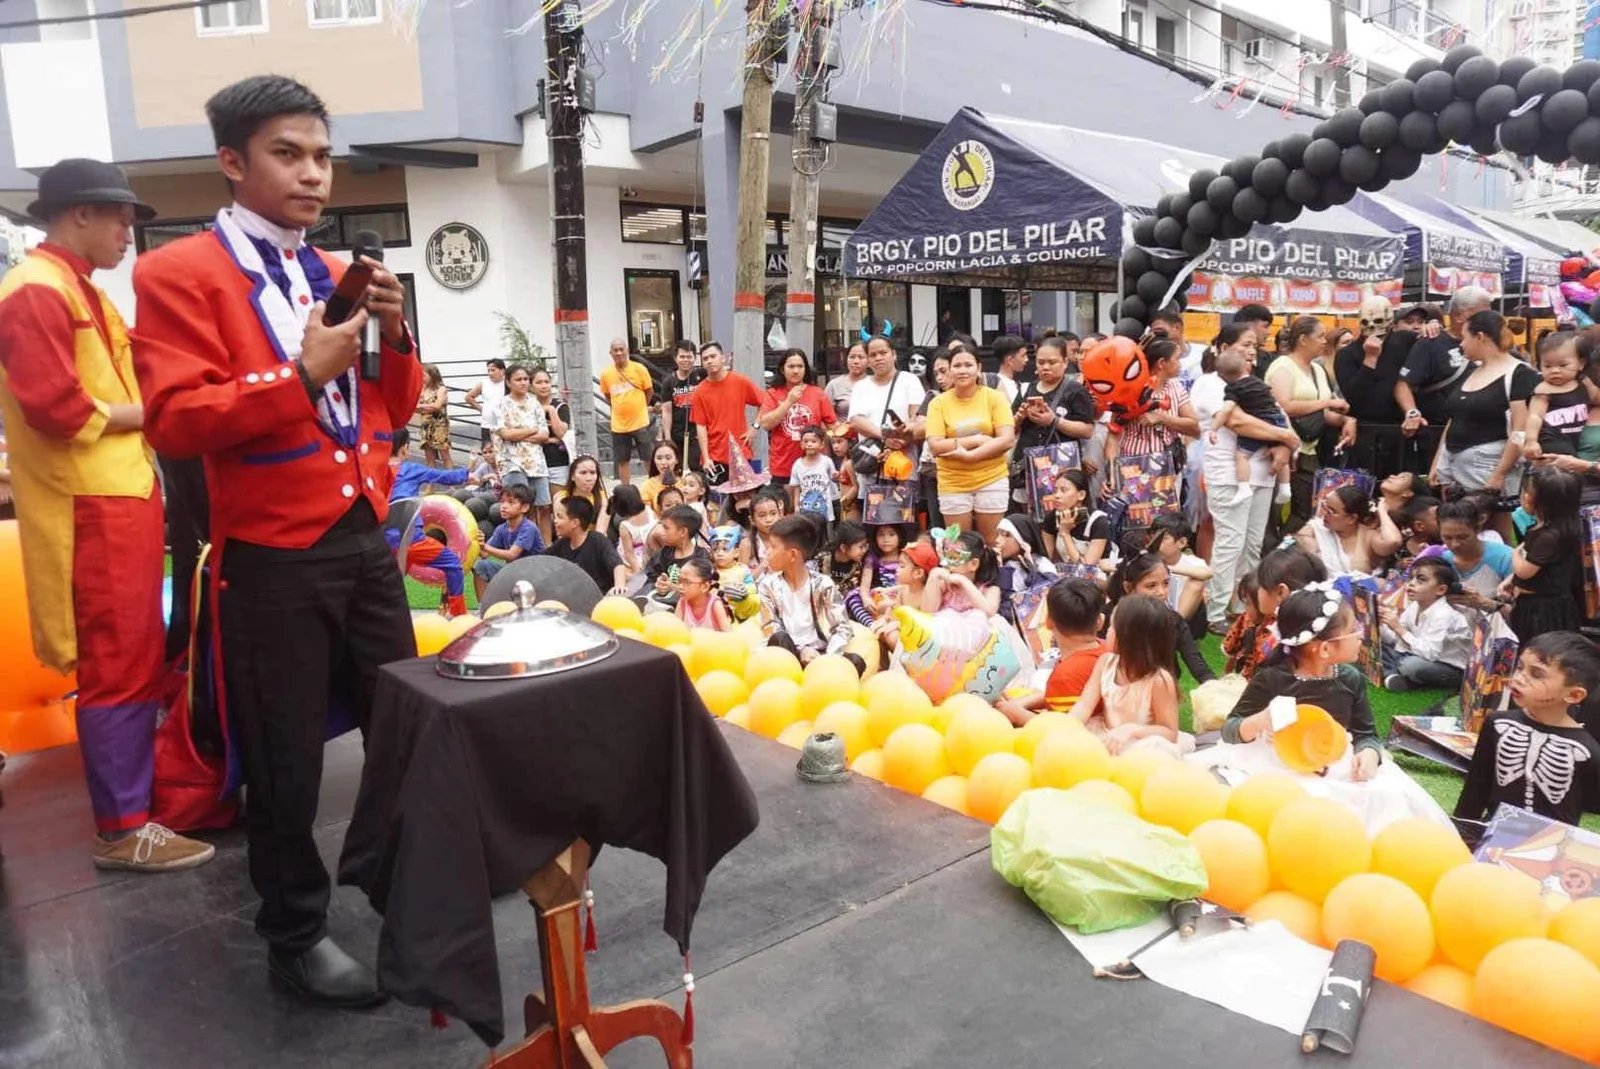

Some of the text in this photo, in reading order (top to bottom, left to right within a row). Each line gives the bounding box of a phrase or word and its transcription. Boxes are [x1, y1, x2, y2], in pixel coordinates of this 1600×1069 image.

[857, 216, 1107, 264] BRGY. PIO DEL PILAR
[856, 246, 1106, 276] KAP. POPCORN LACIA & COUNCIL
[1229, 237, 1276, 262] PIO
[1283, 241, 1328, 266] DEL
[1334, 246, 1397, 270] PILAR
[440, 264, 476, 274] KOCH'S
[444, 272, 473, 282] DINER
[1274, 265, 1320, 277] LACIA
